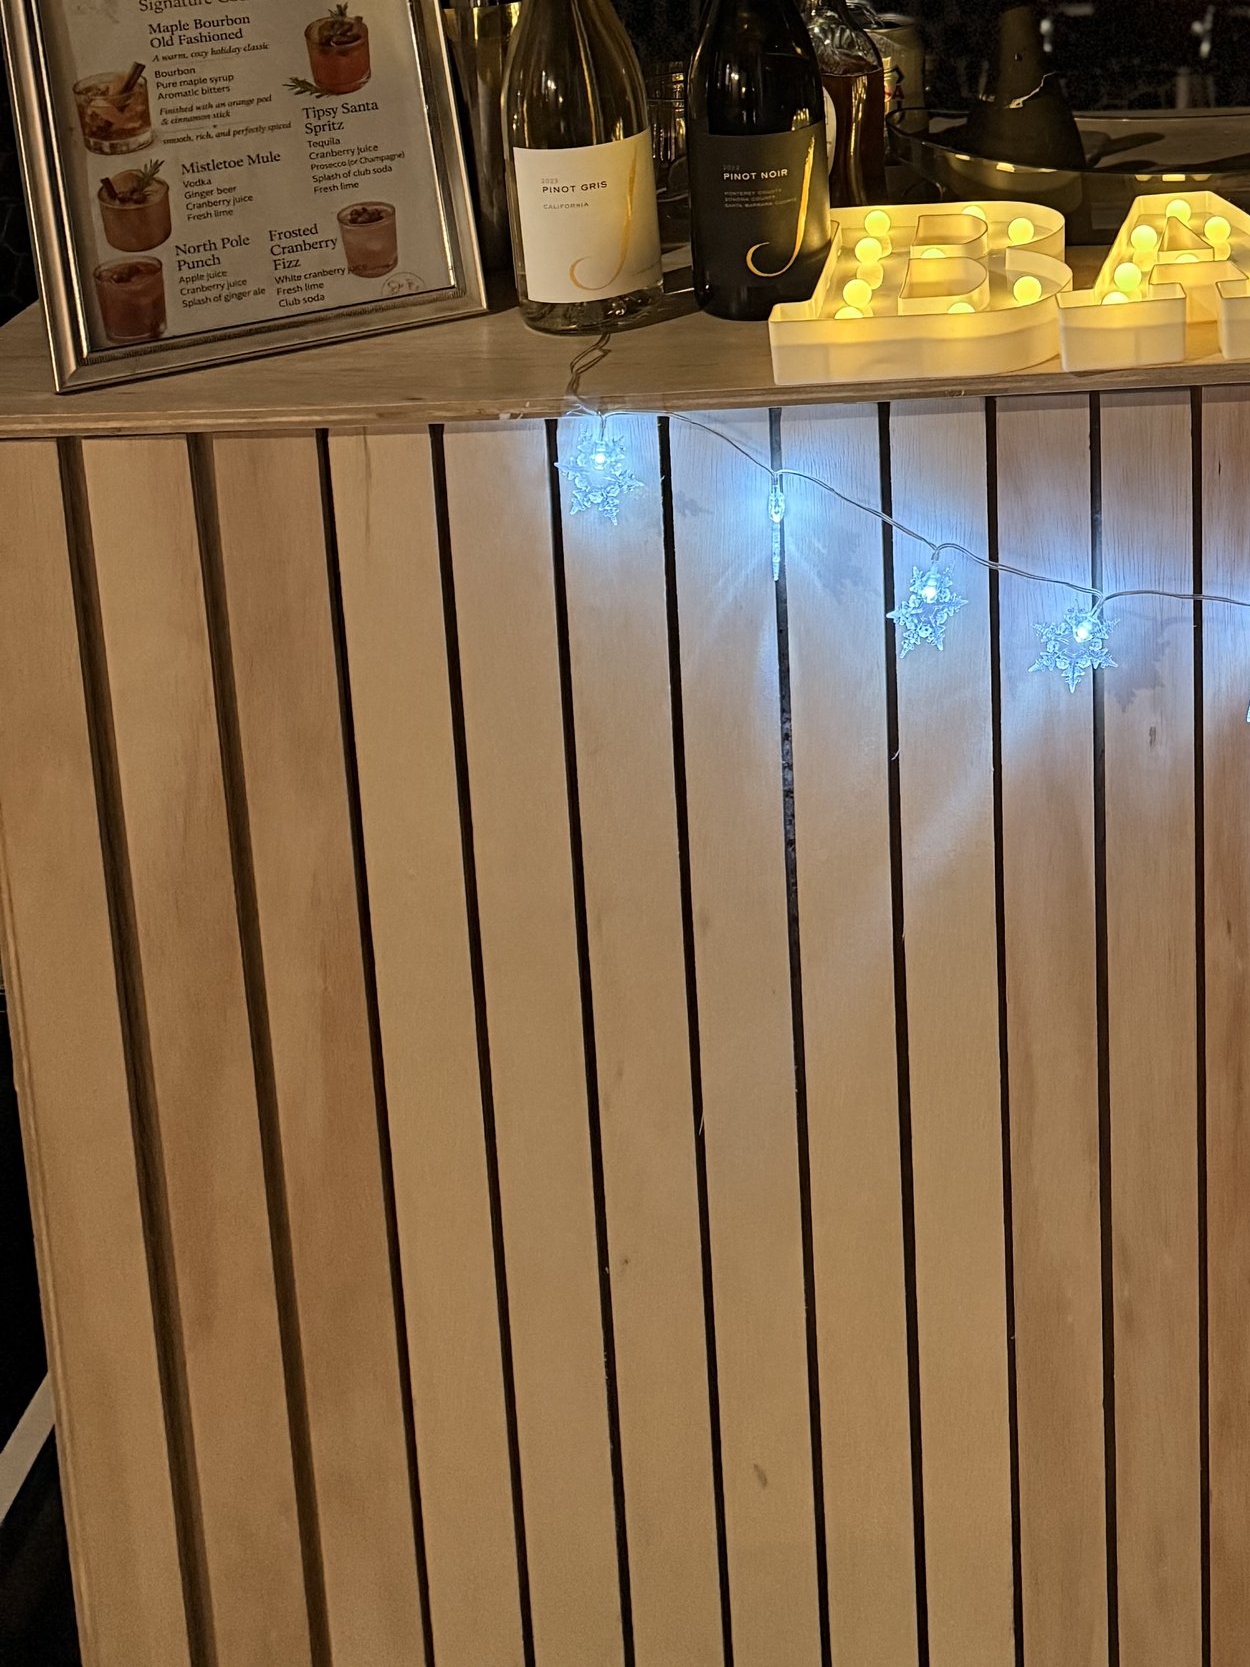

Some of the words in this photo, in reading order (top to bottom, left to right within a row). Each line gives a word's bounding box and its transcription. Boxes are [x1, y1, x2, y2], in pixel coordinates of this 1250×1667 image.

[149, 20, 189, 35] Maple
[194, 15, 250, 30] Bourbon
[150, 34, 174, 49] Old
[178, 28, 243, 46] Fashioned
[211, 45, 241, 56] holiday
[155, 67, 196, 78] Bourbon
[156, 80, 177, 90] Pure
[179, 76, 208, 88] maple
[209, 74, 234, 85] syrup
[158, 88, 199, 100] Aromatic
[201, 85, 230, 95] bitters
[160, 104, 193, 116] Finished
[196, 101, 214, 111] with
[228, 98, 255, 108] orange
[302, 106, 338, 120] Tipsy
[341, 101, 379, 115] Santa
[161, 118, 168, 126] &
[170, 114, 211, 124] cinnamon
[213, 110, 230, 119] stick
[215, 129, 230, 137] and
[232, 124, 266, 137] perfectly
[268, 122, 292, 132] spiced
[305, 121, 345, 136] Spritz
[307, 138, 341, 148] Tequila
[309, 147, 355, 160] Cranberry
[357, 144, 379, 155] juice
[181, 159, 244, 175] Mistletoe
[247, 151, 281, 166] Mule
[311, 161, 347, 171] Prosecco
[348, 159, 358, 167] (or
[360, 150, 405, 164] Champagne)
[312, 171, 341, 184] Splash
[342, 170, 352, 178] of
[353, 167, 371, 177] club
[373, 165, 393, 175] soda
[723, 172, 757, 180] PINOT
[761, 168, 788, 179] NOIR
[183, 178, 212, 188] Vodka
[313, 184, 339, 194] Fresh
[340, 182, 359, 190] lime
[580, 181, 608, 191] GRIS
[184, 189, 214, 200] Ginger
[217, 185, 237, 194] beer
[186, 198, 231, 211] Cranberry
[232, 194, 254, 206] juice
[543, 202, 589, 210] CALIFORNIA
[187, 211, 213, 222] Fresh
[214, 209, 234, 217] lime
[268, 223, 319, 242] Frosted
[175, 240, 217, 256] North
[221, 235, 250, 249] Pole
[270, 236, 338, 256] Cranberry
[177, 254, 221, 271] Punch
[272, 258, 301, 271] Fizz
[178, 273, 205, 284] Apple
[206, 269, 228, 281] juice
[275, 274, 302, 284] White
[304, 266, 346, 279] cranberry
[180, 283, 225, 296] Cranberry
[226, 279, 247, 290] juice
[276, 285, 303, 296] Fresh
[304, 282, 325, 291] lime
[182, 295, 212, 308] Splash
[213, 292, 222, 302] of
[224, 290, 251, 302] ginger
[253, 287, 266, 295] ale
[278, 297, 301, 308] Club
[302, 295, 325, 305] soda
